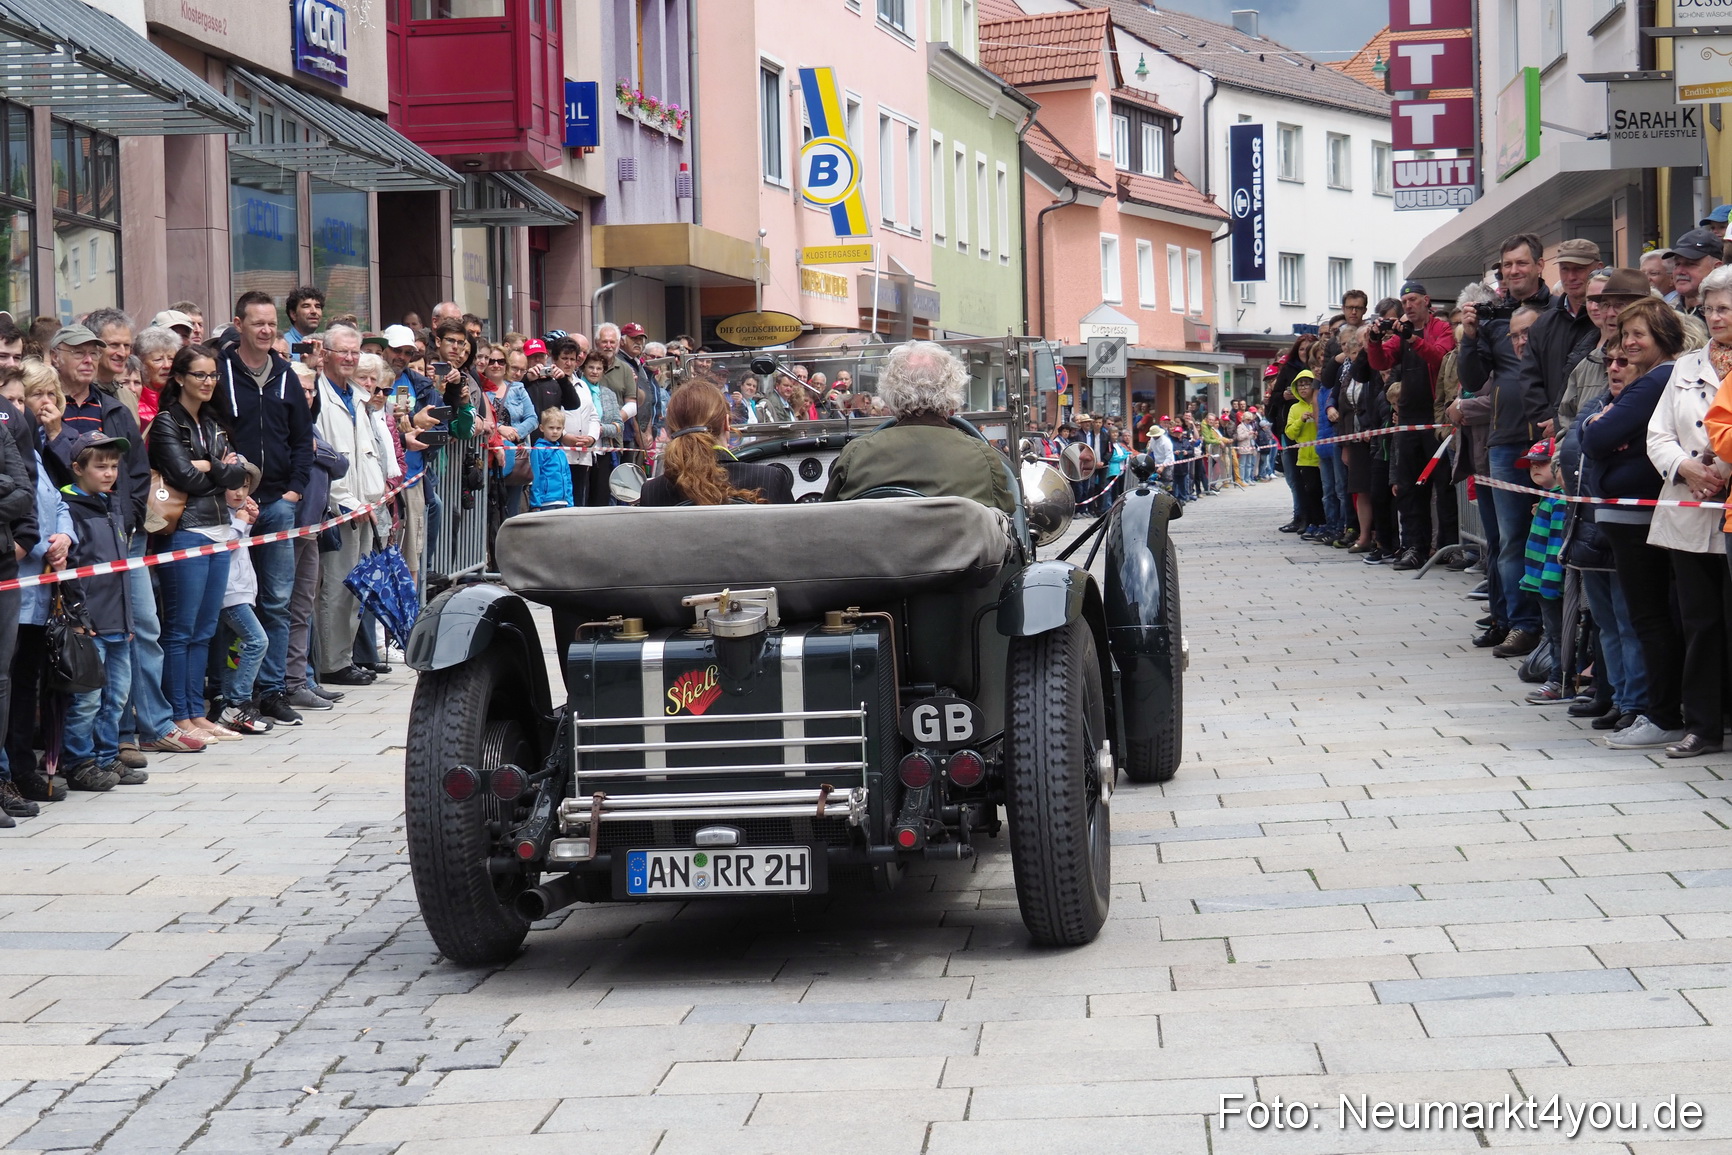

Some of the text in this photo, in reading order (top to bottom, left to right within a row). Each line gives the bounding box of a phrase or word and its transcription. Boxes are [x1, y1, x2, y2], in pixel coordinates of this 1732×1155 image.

[181, 2, 228, 36] Klostergasse 2
[303, 0, 347, 57] CECIL
[1685, 87, 1714, 97] Endlich
[1614, 107, 1697, 130] SARAH K
[1614, 131, 1640, 139] MODE
[1651, 130, 1697, 138] LIFESTYLE
[808, 154, 839, 188] B
[1395, 159, 1471, 187] WITT
[1251, 137, 1264, 268] TOM TAILOR
[1395, 188, 1474, 209] WEIDEN
[247, 198, 283, 241] CECIL
[324, 217, 355, 256] CECIL
[805, 249, 868, 260] KLOSTERGASSE 4
[720, 324, 801, 334] DIE GOLDSCHMIEDE
[1091, 324, 1128, 336] Creppresso
[665, 664, 721, 716] Shell
[911, 703, 975, 743] GB
[634, 877, 642, 886] D
[648, 853, 807, 888] AN RR 2H
